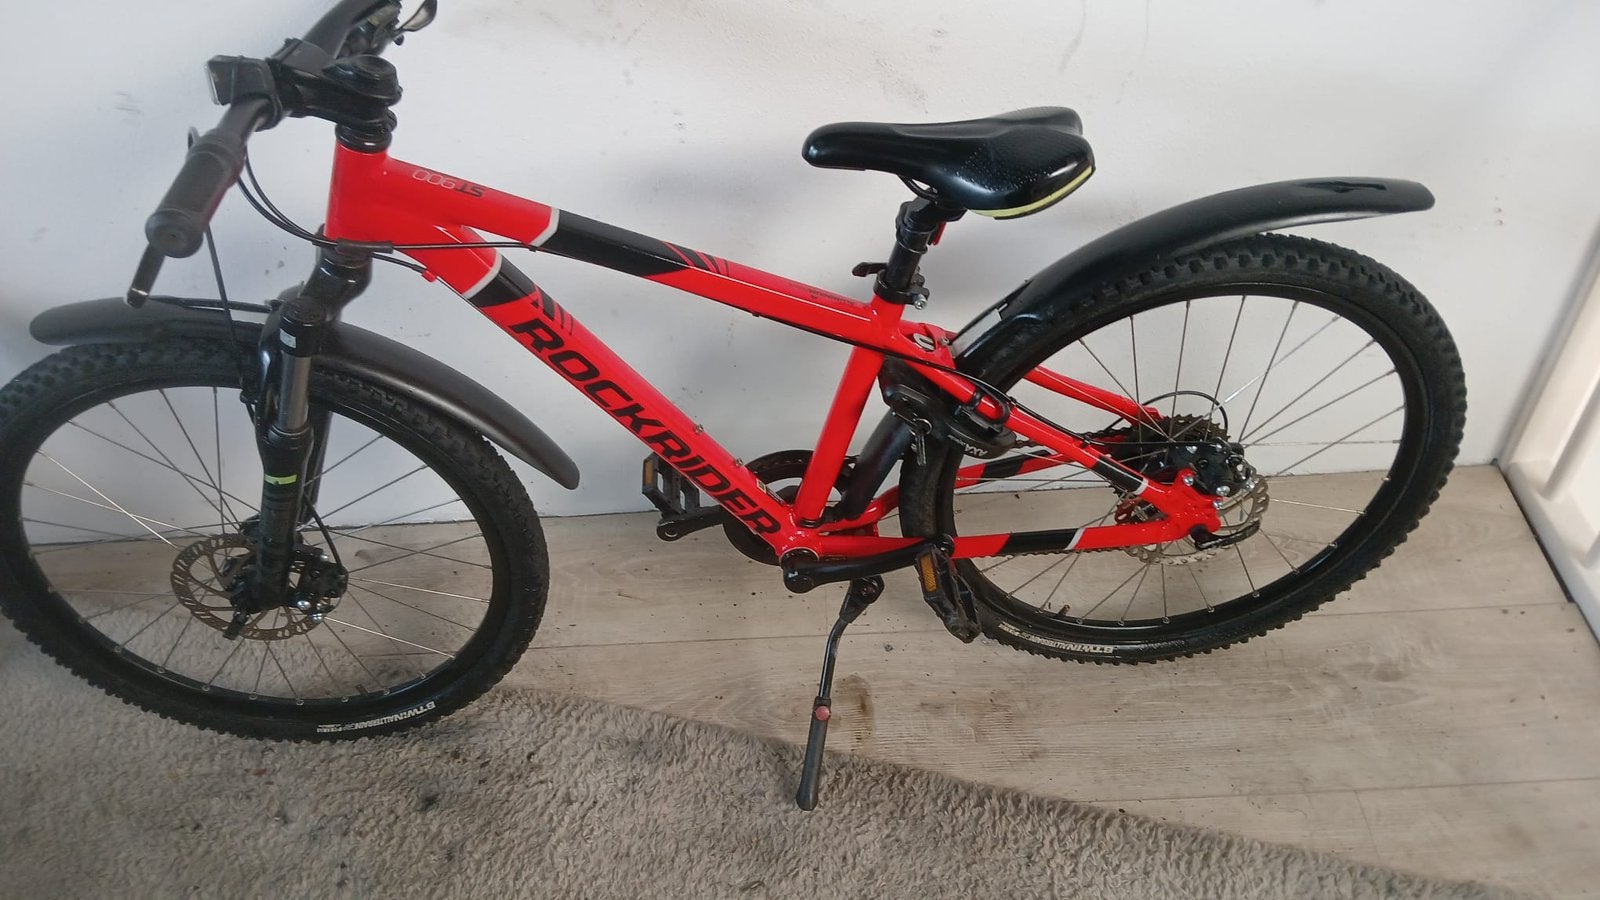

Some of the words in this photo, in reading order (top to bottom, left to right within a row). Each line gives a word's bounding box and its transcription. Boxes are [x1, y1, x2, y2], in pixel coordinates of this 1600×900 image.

[412, 169, 485, 198] ST900
[508, 318, 781, 534] ROCKRIDER
[965, 443, 988, 457] AXA
